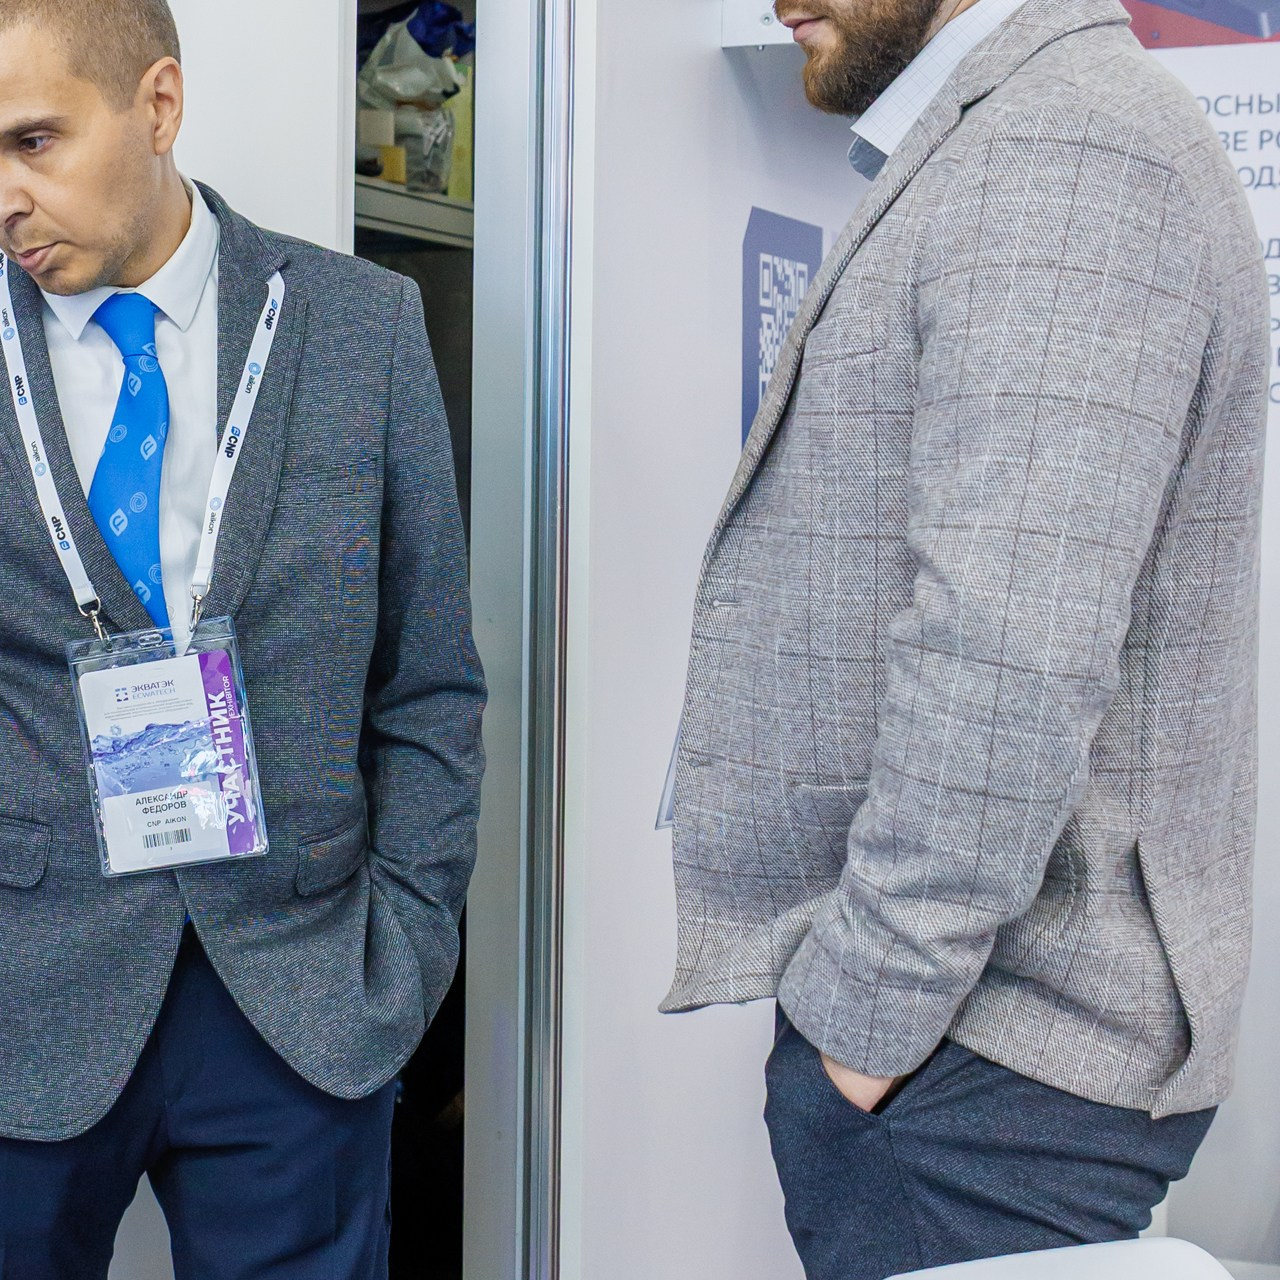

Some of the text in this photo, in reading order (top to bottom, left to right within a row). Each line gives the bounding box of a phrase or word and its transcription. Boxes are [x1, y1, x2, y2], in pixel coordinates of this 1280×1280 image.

[264, 308, 276, 331] CNP
[14, 375, 25, 397] CNP
[224, 435, 238, 459] CNP
[51, 516, 66, 541] CNP
[130, 679, 175, 693] ЭКВАТЭК
[132, 687, 176, 700] ECWATECH
[222, 675, 236, 718] EXHIBITOR
[135, 790, 189, 806] АЛЕКСАНДР
[142, 800, 187, 815] ФЕДОРОВ
[147, 815, 187, 828] CNP AIKON
